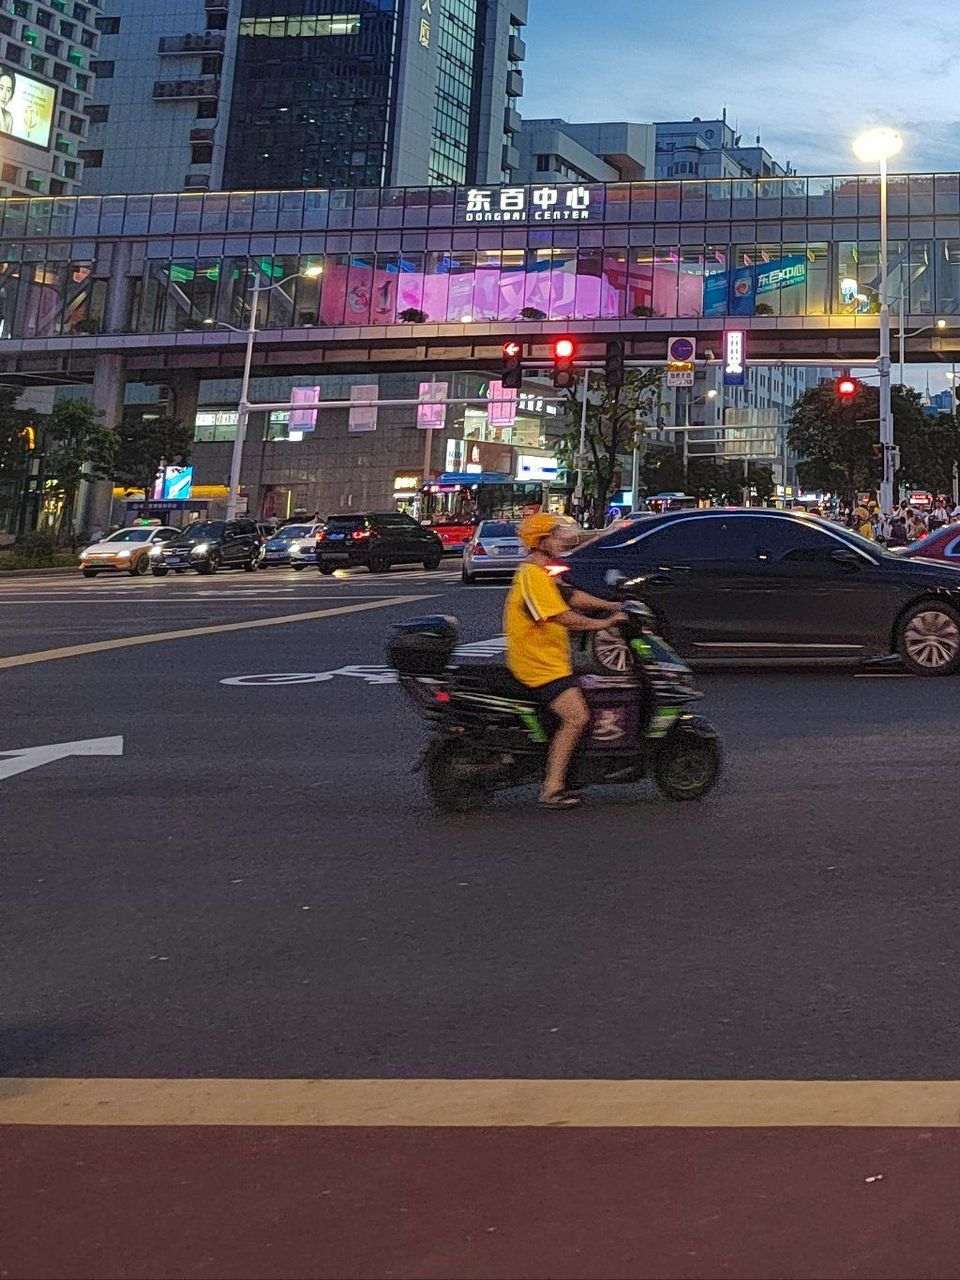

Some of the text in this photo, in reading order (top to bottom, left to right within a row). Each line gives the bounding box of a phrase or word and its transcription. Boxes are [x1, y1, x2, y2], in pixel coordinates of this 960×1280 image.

[466, 186, 590, 211] 东百中心
[465, 210, 589, 221] DONGBAI CENTER
